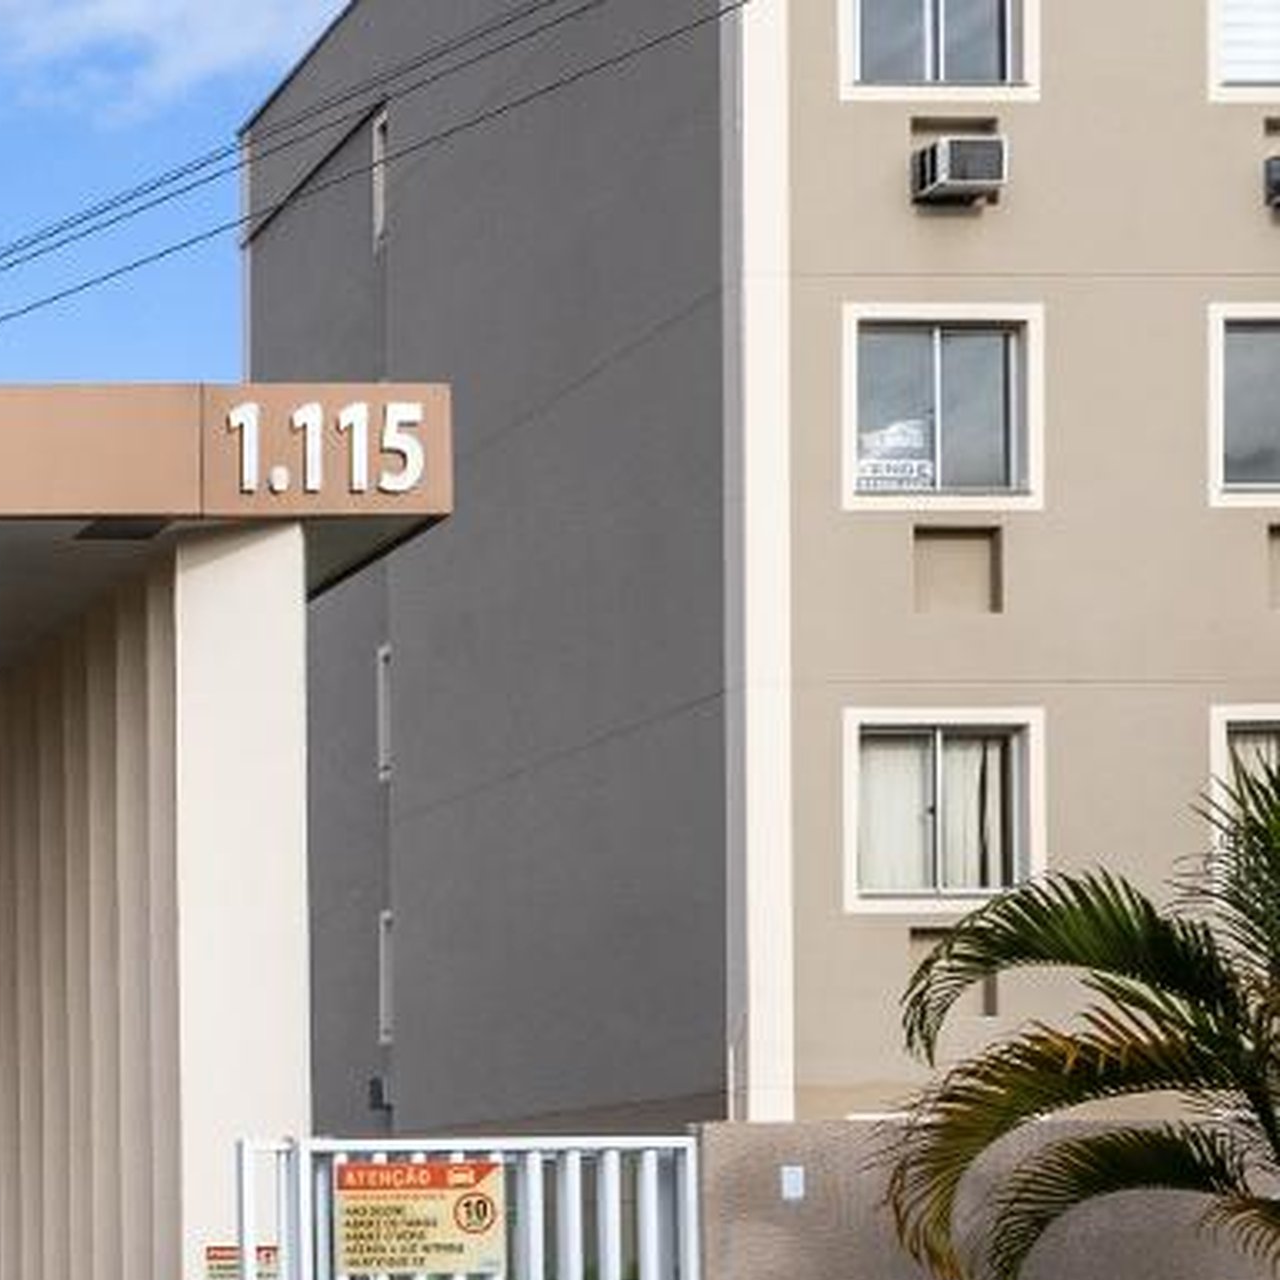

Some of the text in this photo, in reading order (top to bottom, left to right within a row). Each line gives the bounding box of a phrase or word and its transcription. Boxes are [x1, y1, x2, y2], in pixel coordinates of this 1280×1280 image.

[228, 401, 425, 493] 1.115
[344, 1167, 432, 1189] ATENÇÃO
[462, 1199, 488, 1221] 10
